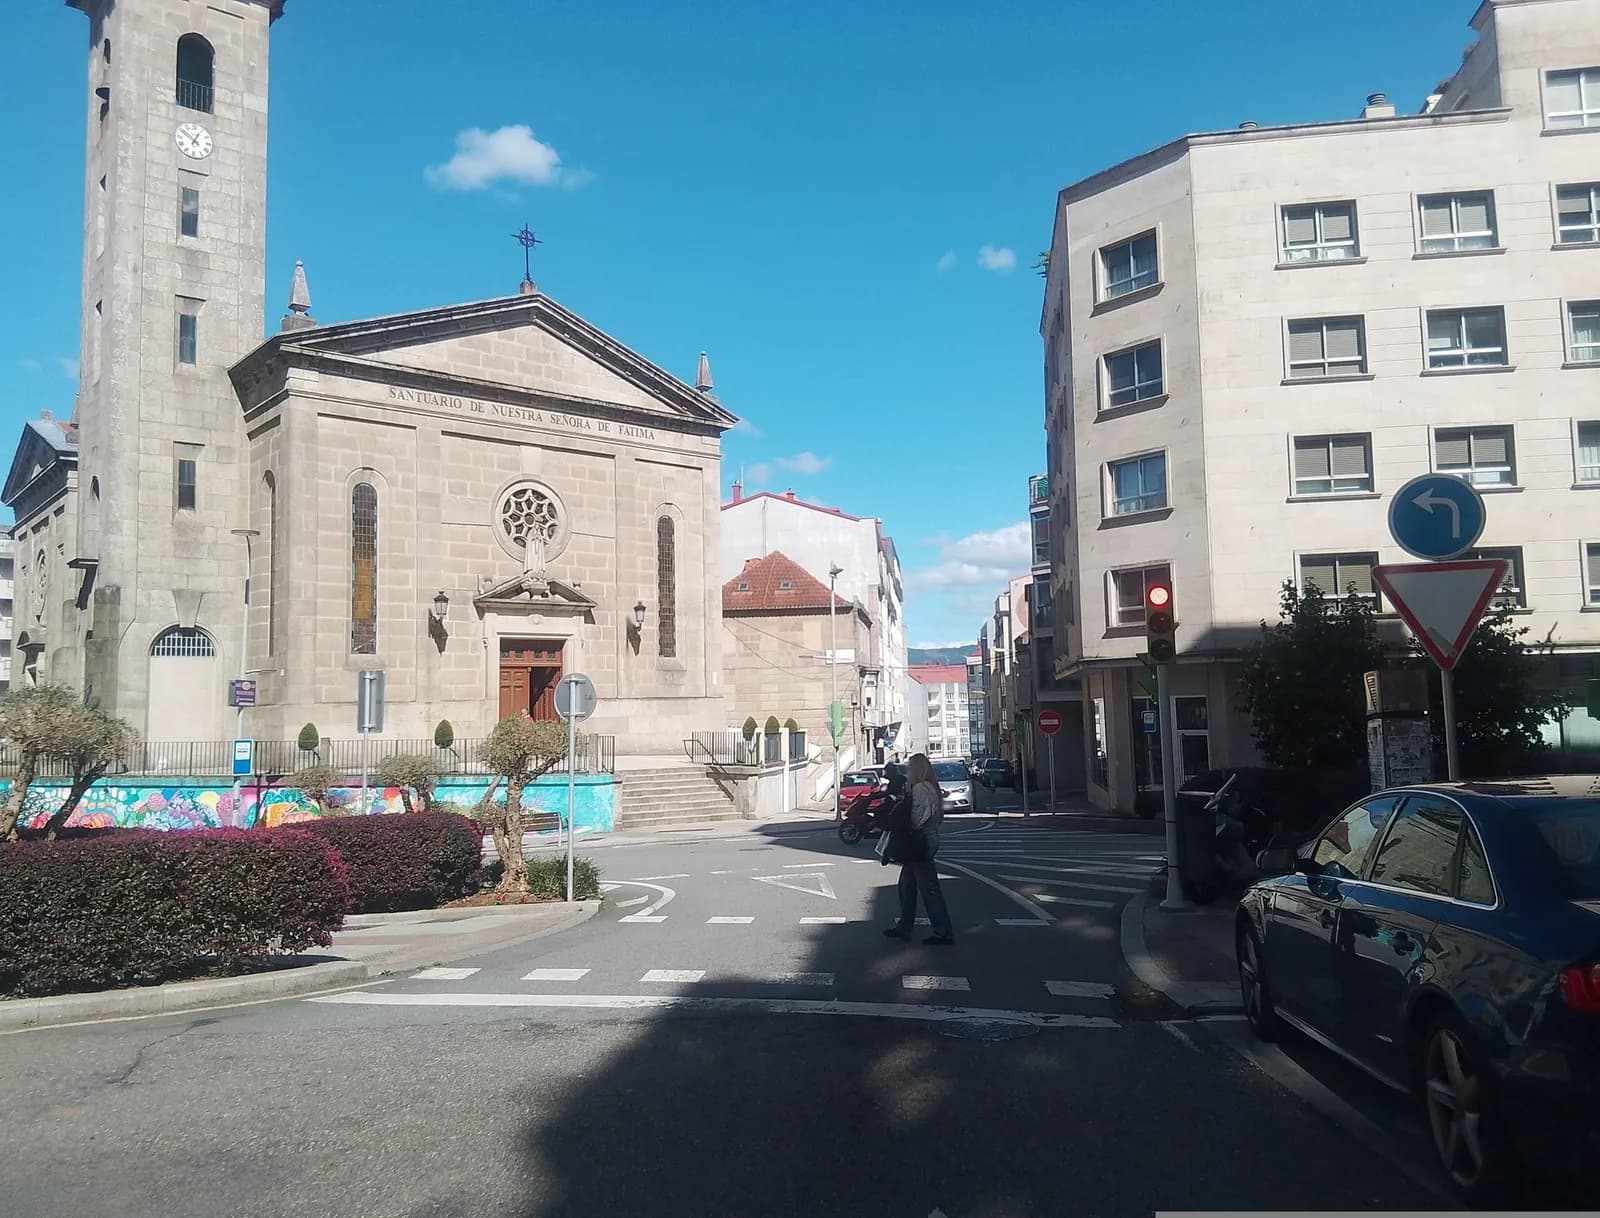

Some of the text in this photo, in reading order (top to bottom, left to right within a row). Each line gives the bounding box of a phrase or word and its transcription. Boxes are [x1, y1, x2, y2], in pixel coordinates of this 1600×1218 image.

[389, 387, 462, 409] SANTUARIO
[470, 401, 485, 413] DE
[492, 404, 543, 422] NUESTRA
[550, 413, 591, 430] SEÑORA
[598, 421, 611, 433] DE
